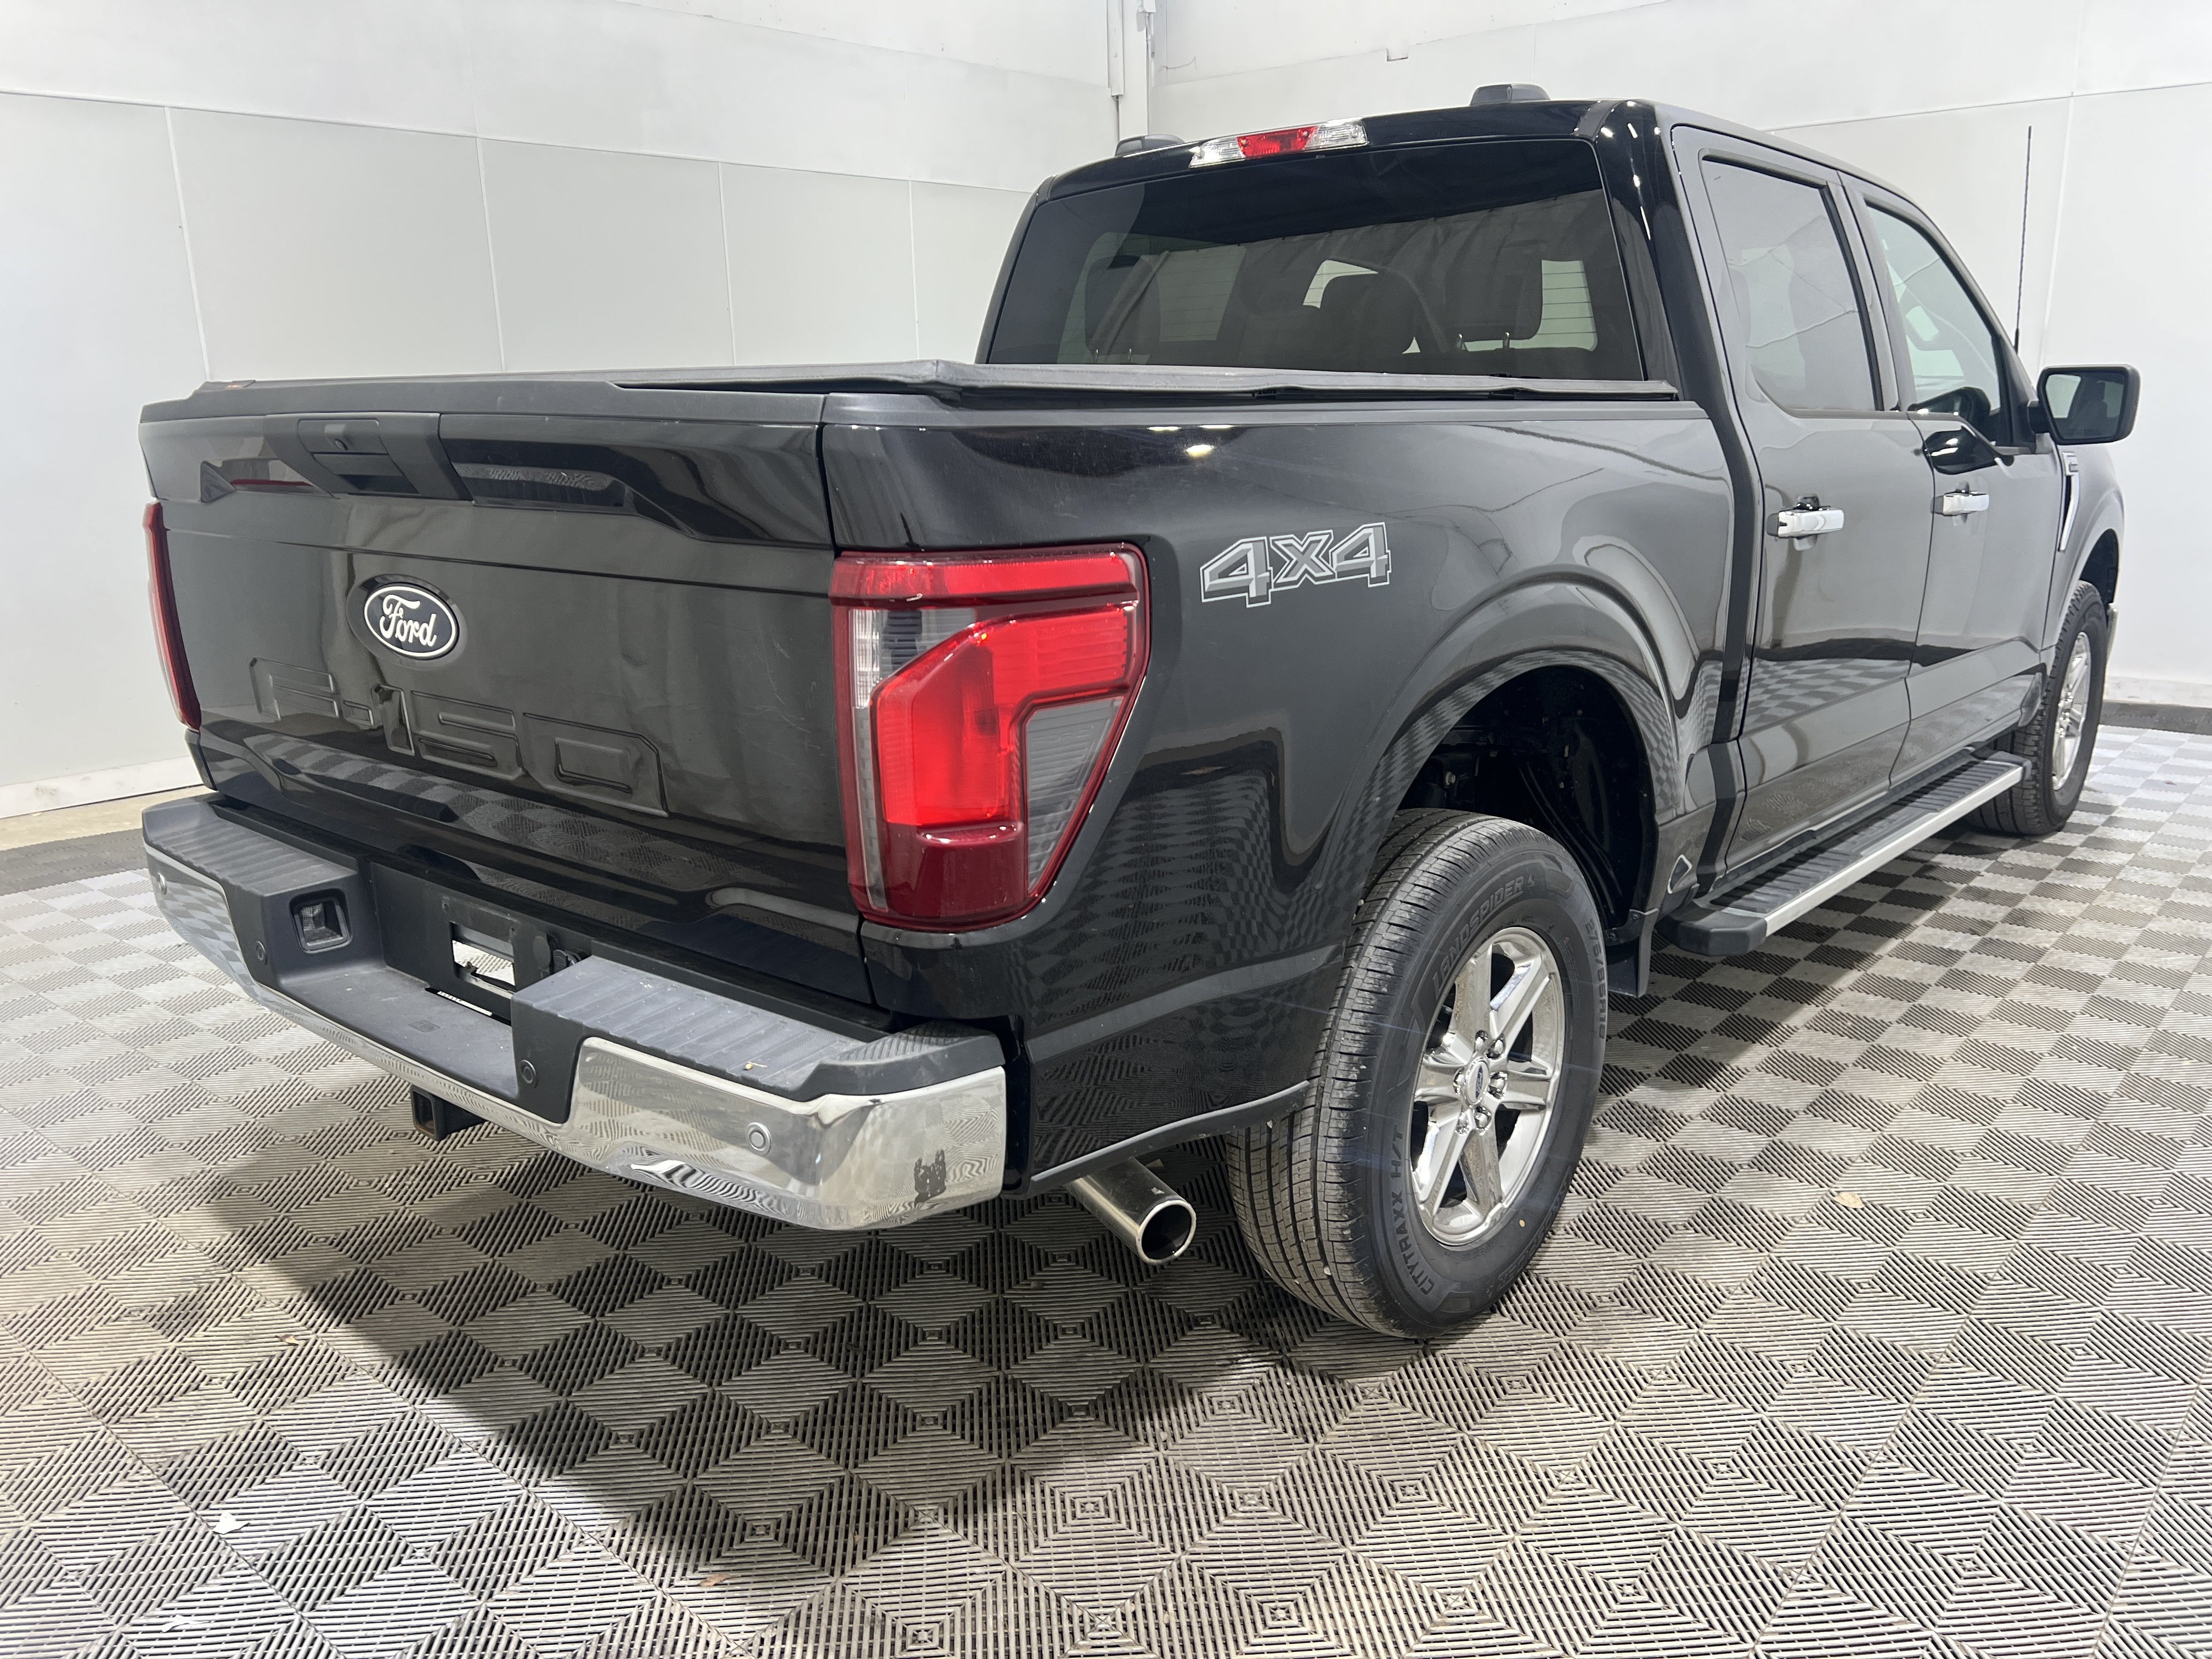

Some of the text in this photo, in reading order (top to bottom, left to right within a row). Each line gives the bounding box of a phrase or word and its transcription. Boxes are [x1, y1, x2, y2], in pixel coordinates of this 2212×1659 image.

[379, 594, 437, 647] Ford
[250, 657, 670, 818] F-150
[1432, 876, 1525, 1000] LANDSPIDER
[1390, 1125, 1435, 1295] CITYTRAXX H/T
